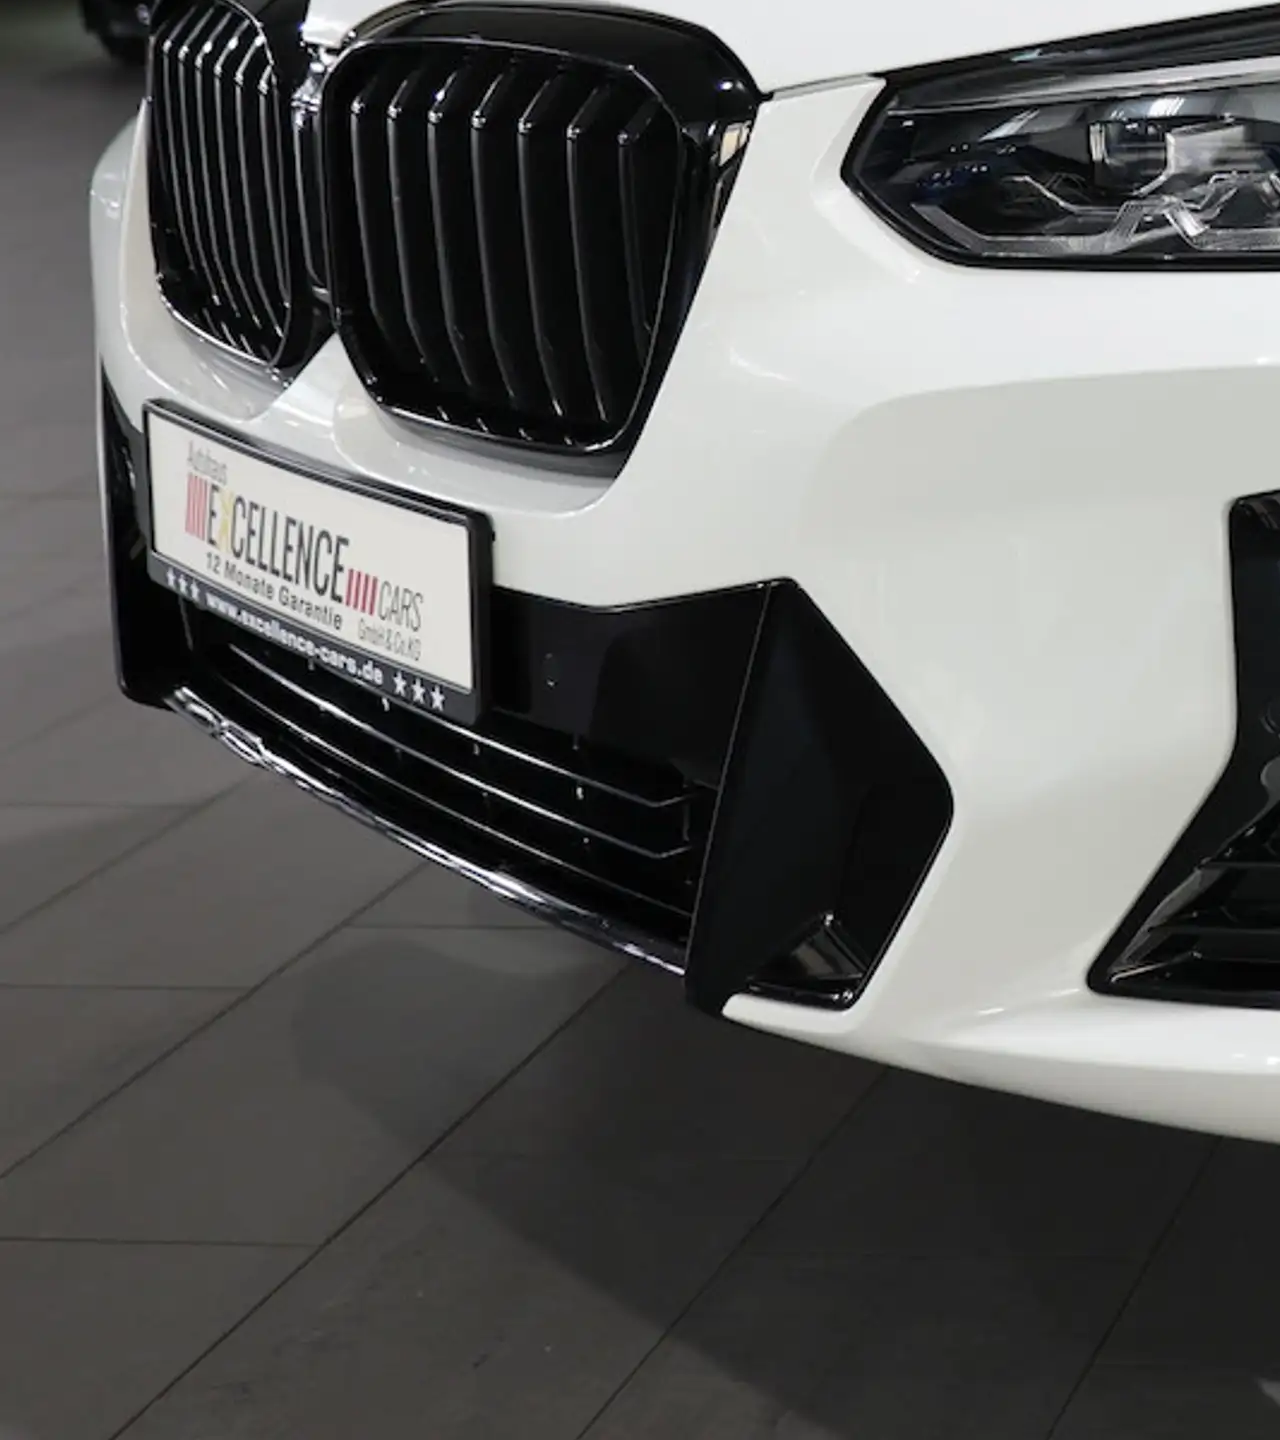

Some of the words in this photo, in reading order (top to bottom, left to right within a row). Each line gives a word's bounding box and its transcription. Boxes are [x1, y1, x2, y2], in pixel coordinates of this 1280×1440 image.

[207, 483, 349, 603] EXCELLENCE
[206, 551, 221, 575] 12
[224, 560, 274, 601] Monate
[278, 585, 343, 630] Garantie
[377, 580, 424, 633] CARS
[205, 591, 384, 686] www.excellence-cars.de
